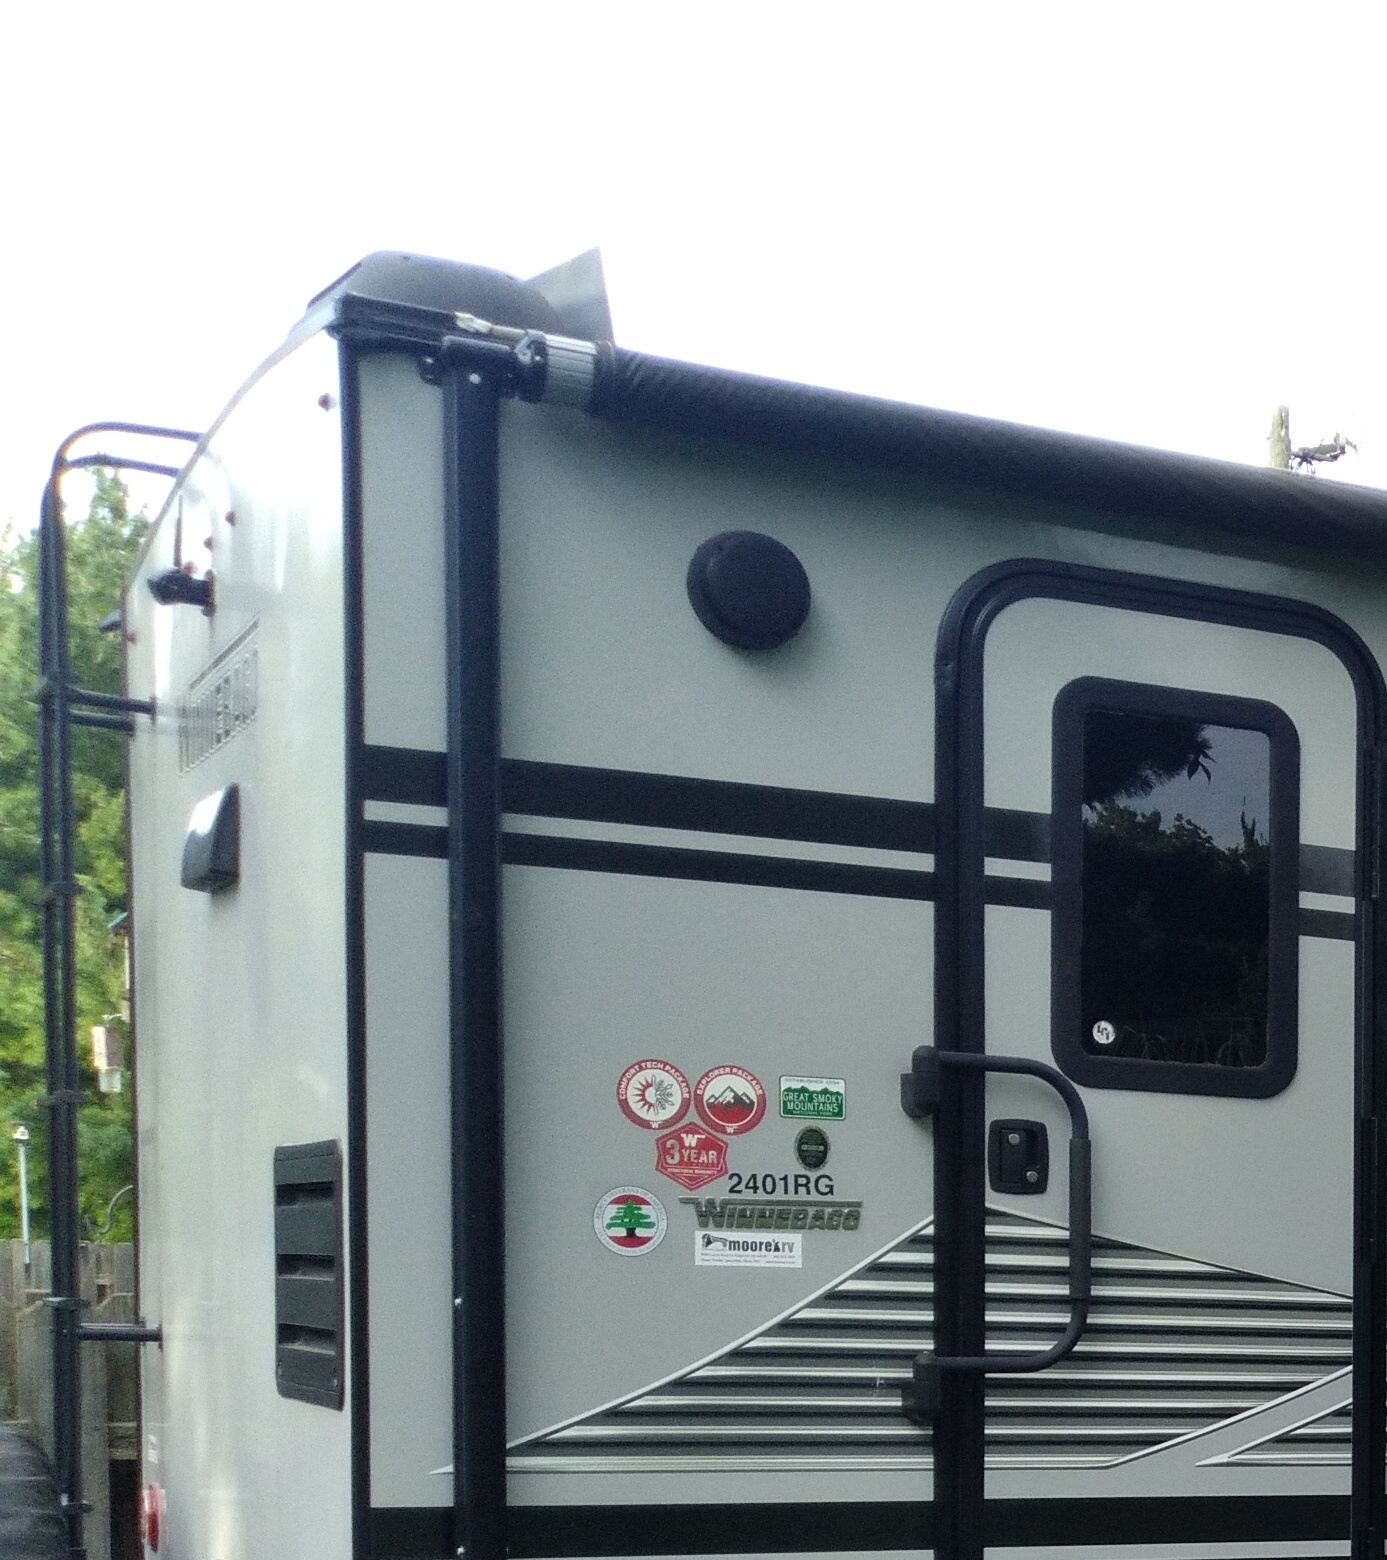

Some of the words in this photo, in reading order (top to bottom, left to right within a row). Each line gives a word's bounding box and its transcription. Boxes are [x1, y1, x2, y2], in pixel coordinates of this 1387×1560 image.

[619, 1064, 640, 1099] COMFORT
[642, 1061, 664, 1069] TECH
[664, 1063, 690, 1099] PACKAGE
[696, 1067, 731, 1095] EXPLORER
[732, 1067, 763, 1095] PACKAGE
[783, 1091, 809, 1102] GREAT
[812, 1093, 843, 1104] SMOKY
[787, 1101, 839, 1113] MOUNTAINS
[665, 1139, 680, 1165] 3
[681, 1148, 717, 1164] YEAR
[728, 1172, 835, 1196] 2401RG
